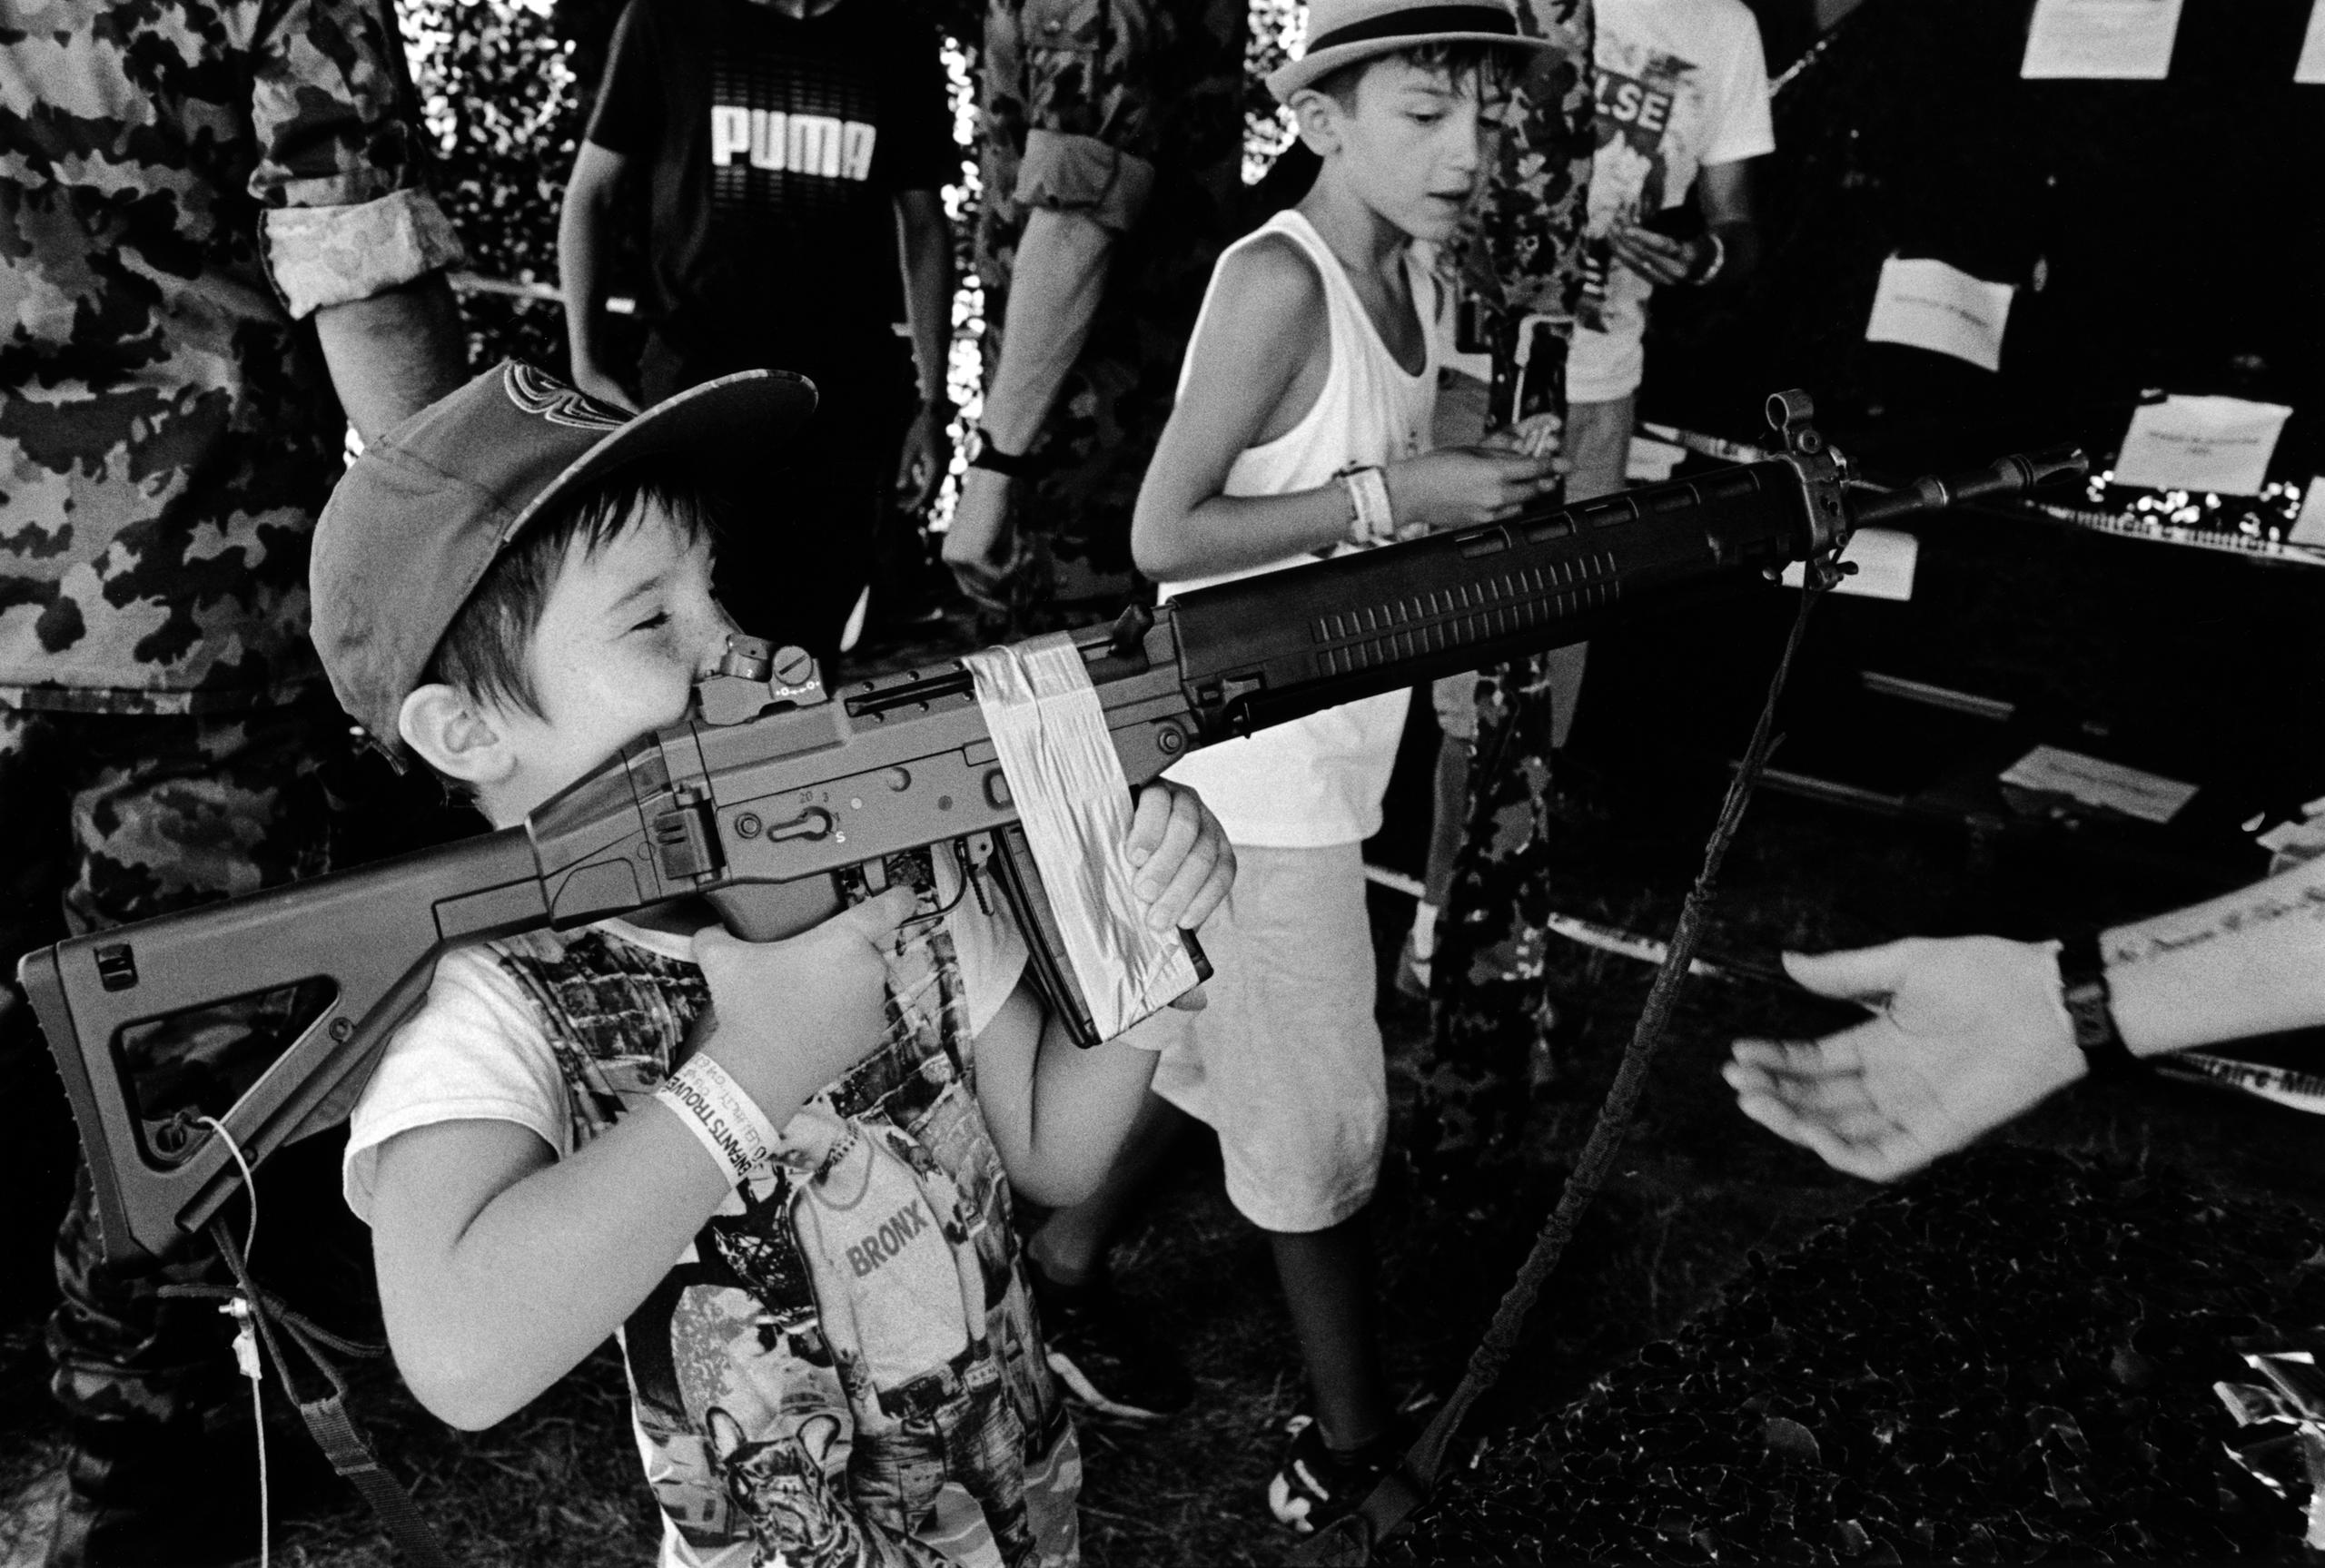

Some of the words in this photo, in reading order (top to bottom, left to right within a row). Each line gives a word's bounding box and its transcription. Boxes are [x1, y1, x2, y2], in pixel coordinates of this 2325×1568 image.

[1594, 73, 1669, 132] LSE
[711, 104, 876, 181] PUMA
[836, 831, 846, 843] S
[708, 1119, 752, 1177] ENFANTS
[846, 1199, 929, 1277] BRONX
